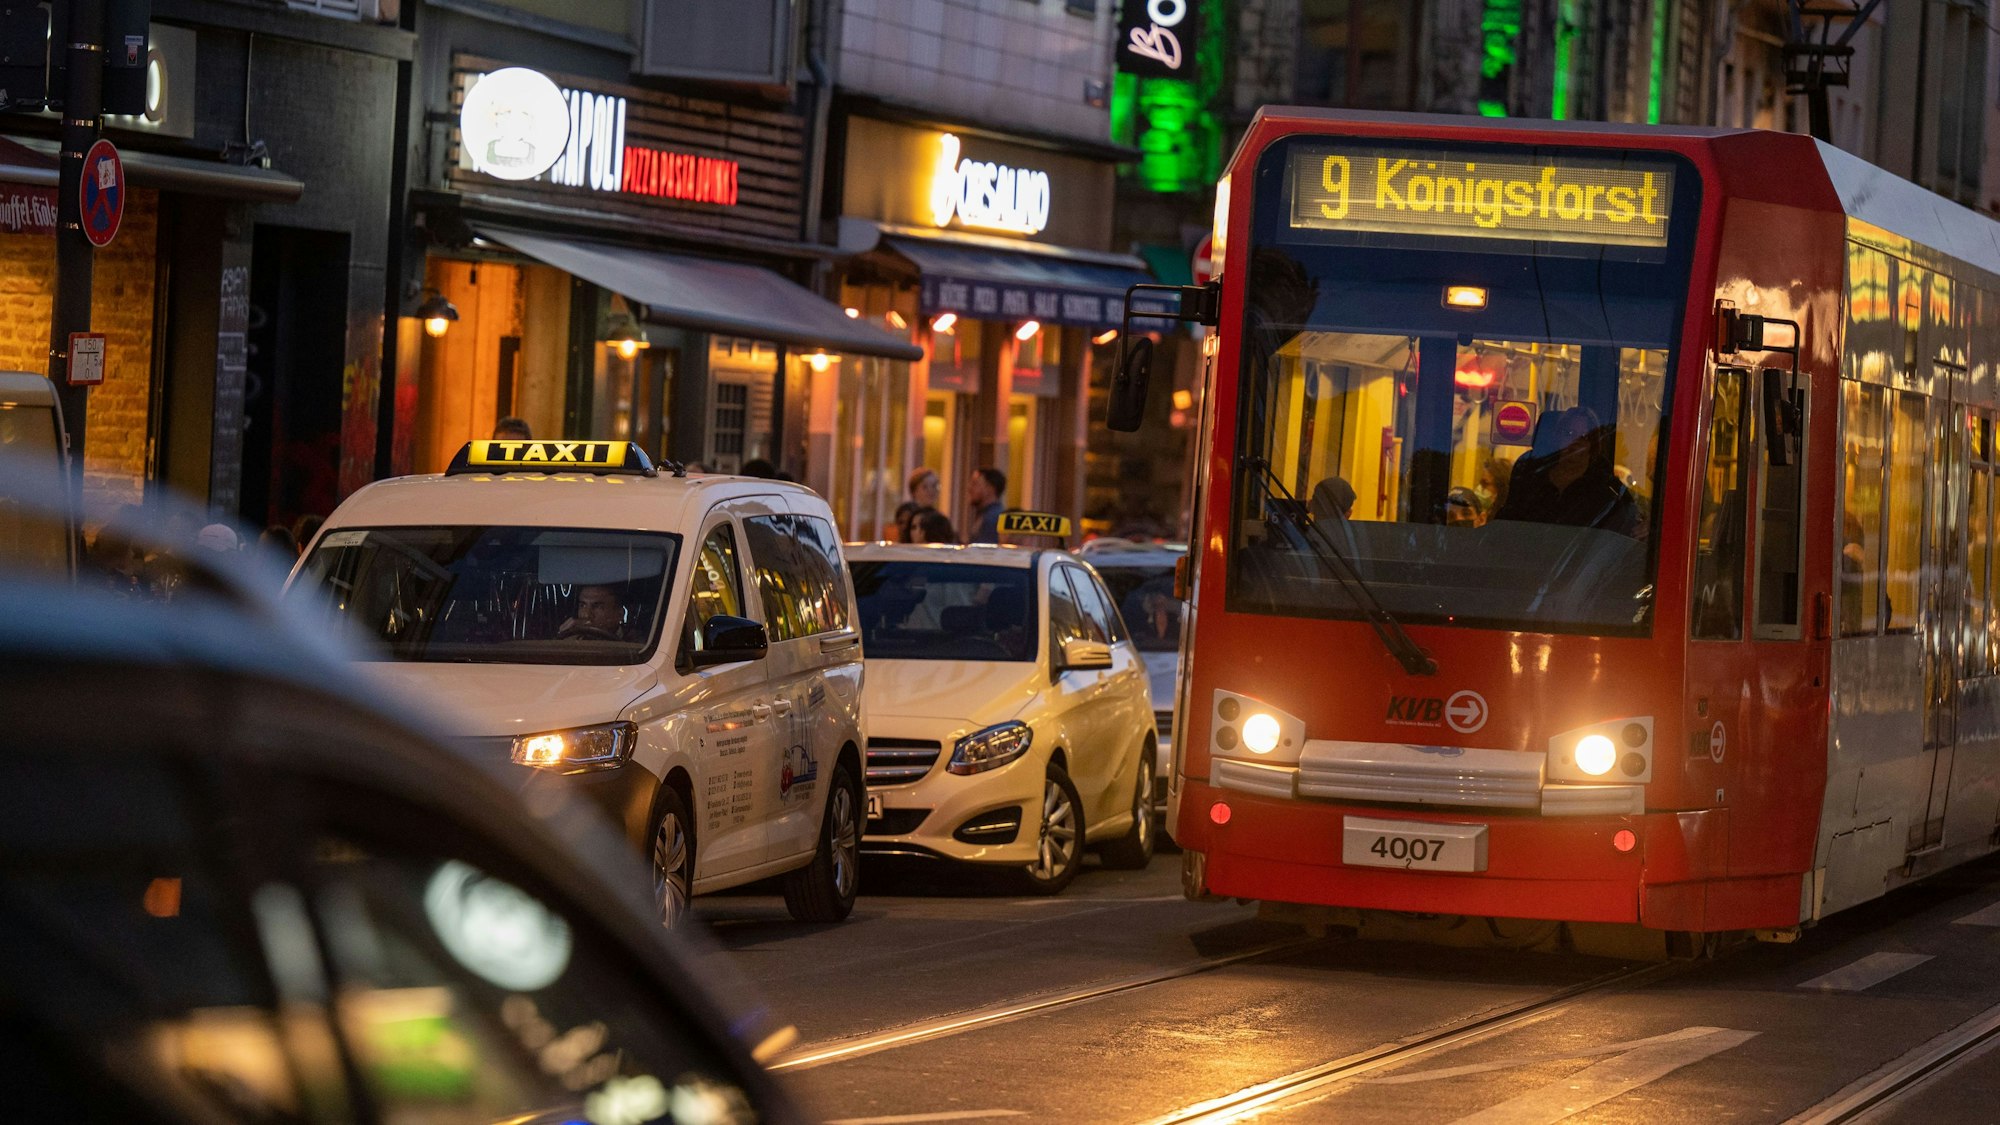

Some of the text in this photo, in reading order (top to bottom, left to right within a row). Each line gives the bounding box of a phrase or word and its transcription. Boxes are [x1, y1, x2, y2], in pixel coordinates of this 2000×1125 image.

[1321, 155, 1658, 228] 9 Königsforst
[500, 443, 595, 462] TAXI
[1010, 515, 1056, 531] TAXI
[1386, 696, 1443, 721] KVB
[1371, 836, 1446, 862] 4007
